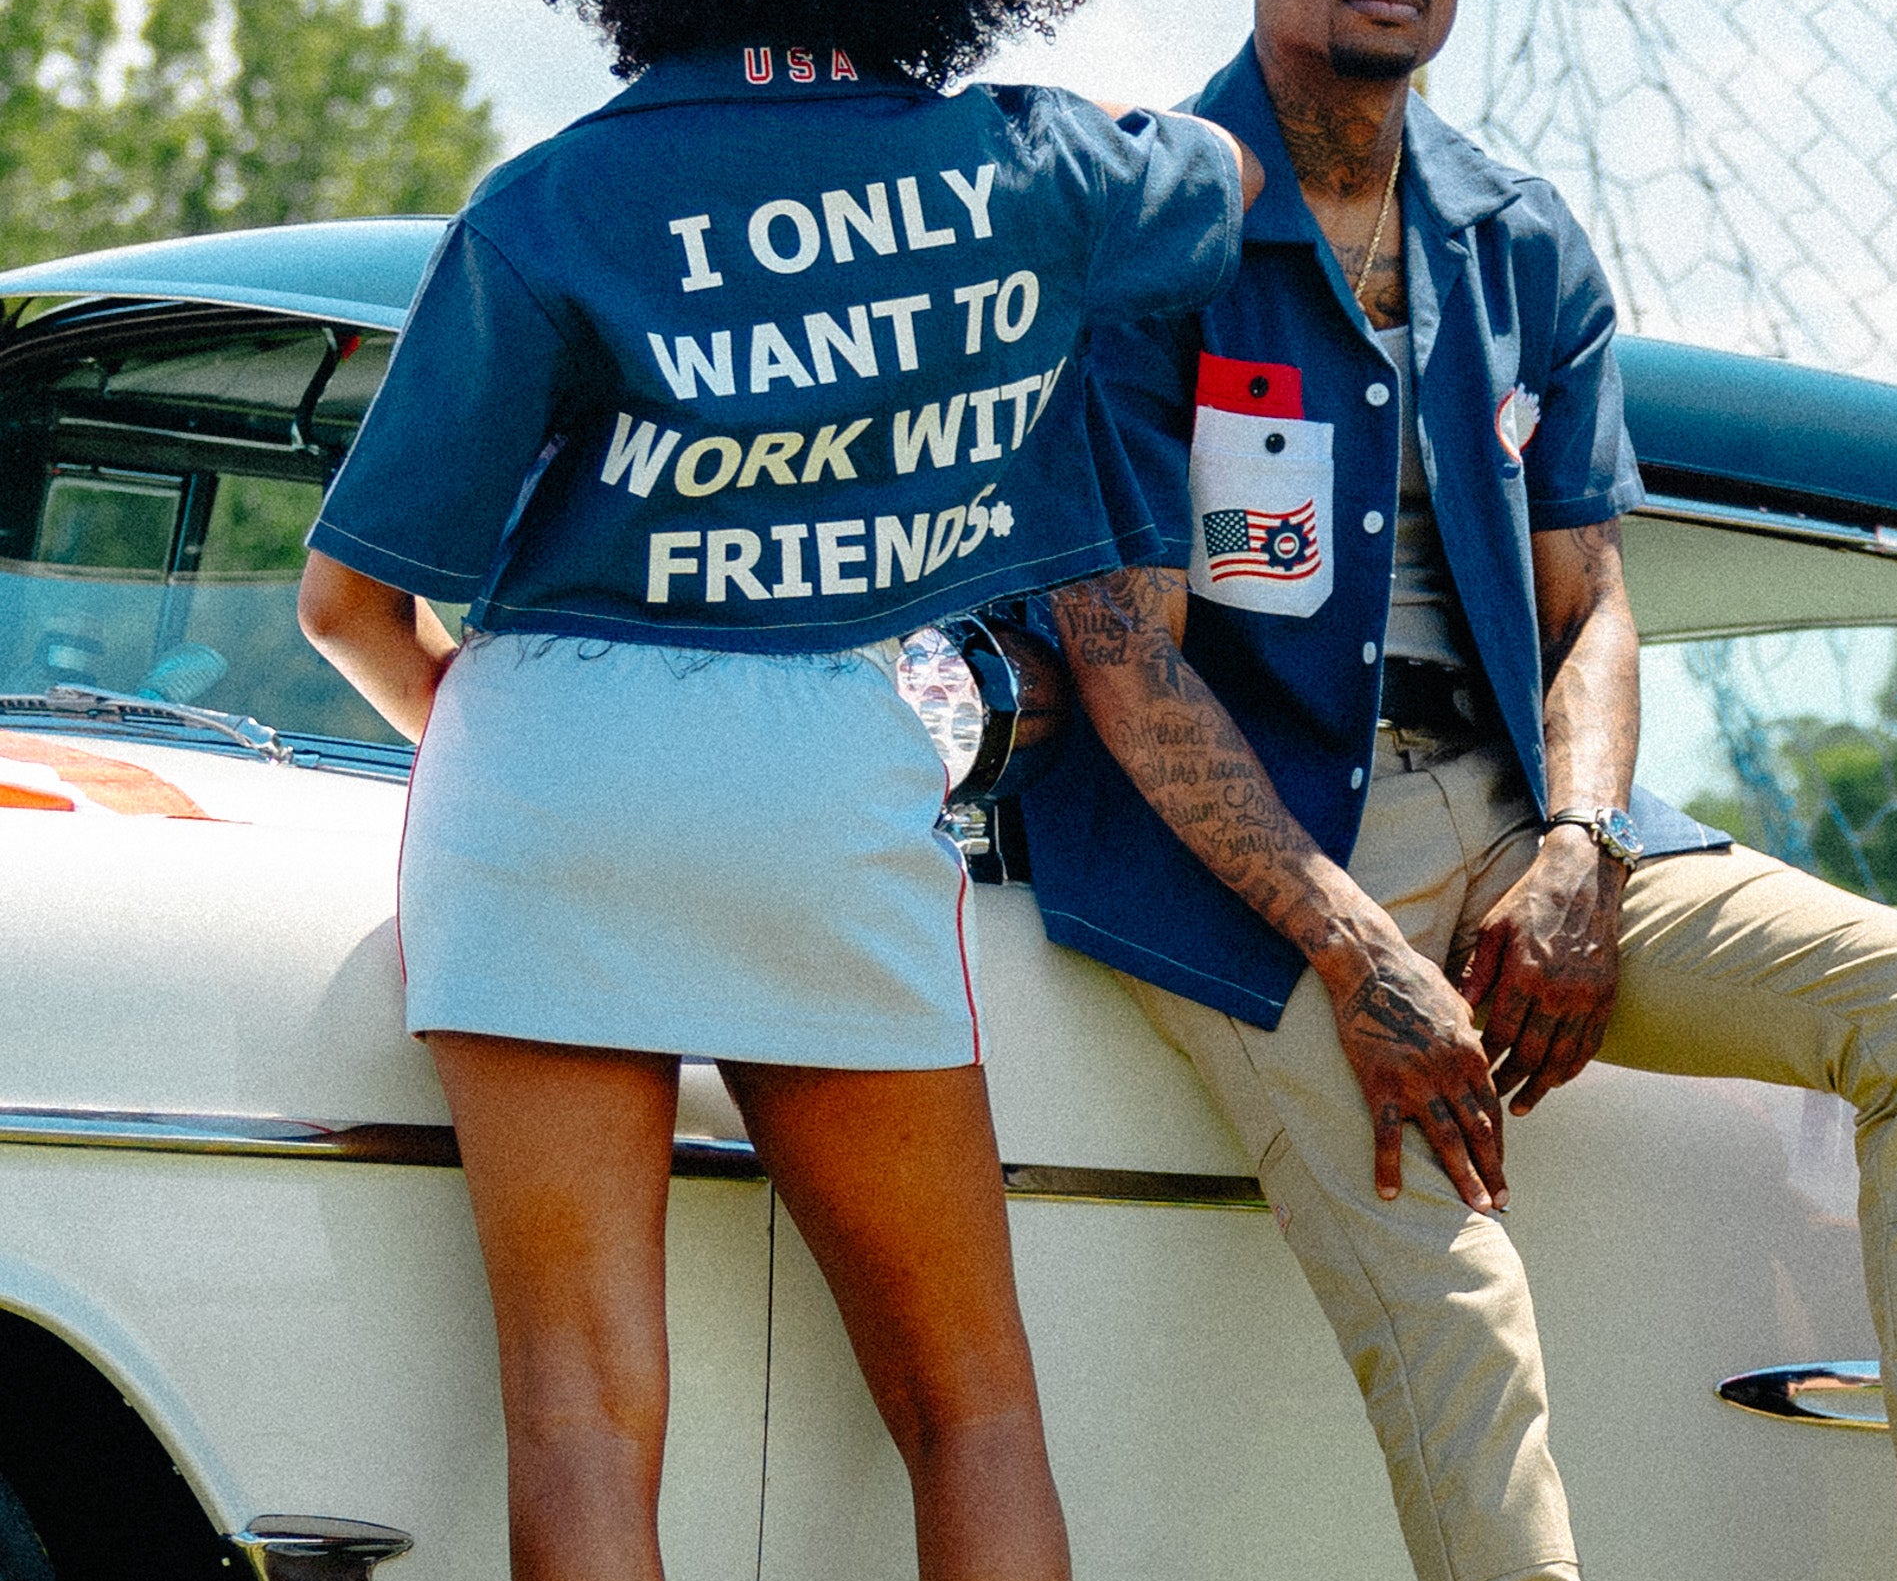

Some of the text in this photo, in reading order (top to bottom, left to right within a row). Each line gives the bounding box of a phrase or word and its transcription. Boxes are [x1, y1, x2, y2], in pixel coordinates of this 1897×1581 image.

[744, 46, 859, 85] USA
[670, 163, 999, 291] I ONLY
[648, 270, 1039, 400] WANT TO
[602, 414, 871, 497] WORK
